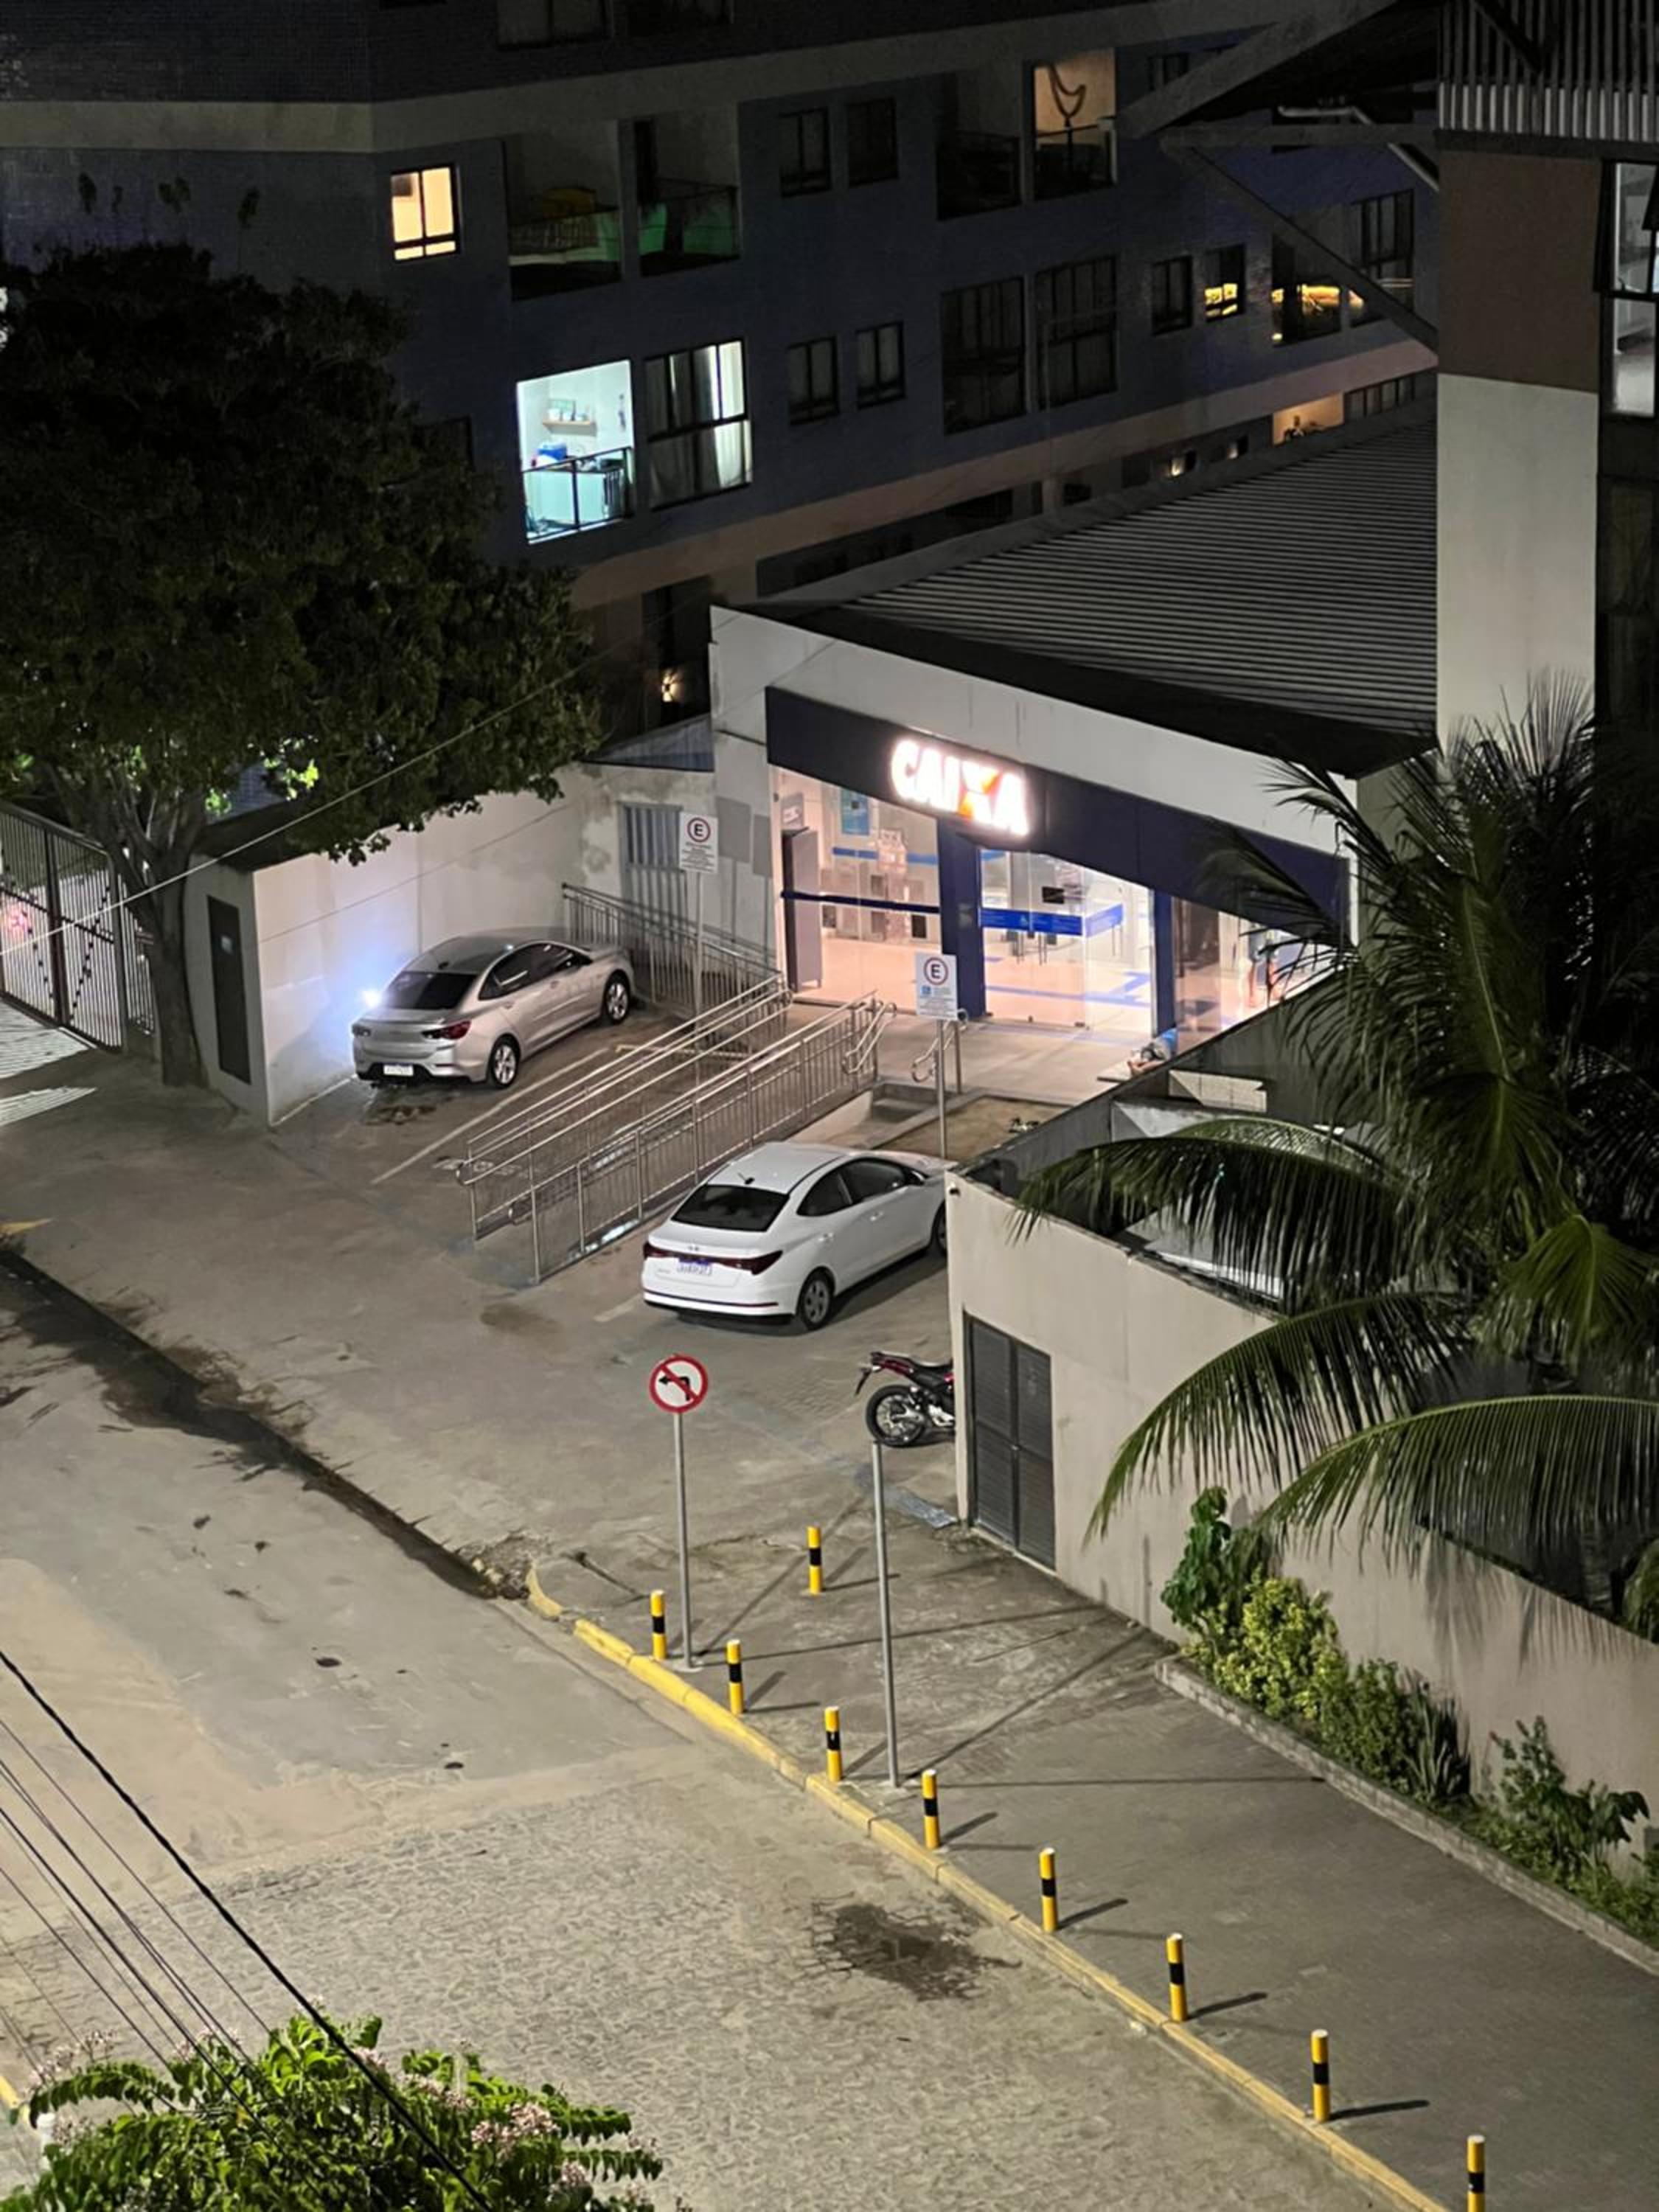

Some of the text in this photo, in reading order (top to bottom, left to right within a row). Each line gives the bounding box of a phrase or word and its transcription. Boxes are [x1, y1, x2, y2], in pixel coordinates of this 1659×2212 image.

[891, 739, 1029, 837] CAIXA
[695, 823, 703, 837] E
[931, 964, 941, 979] E
